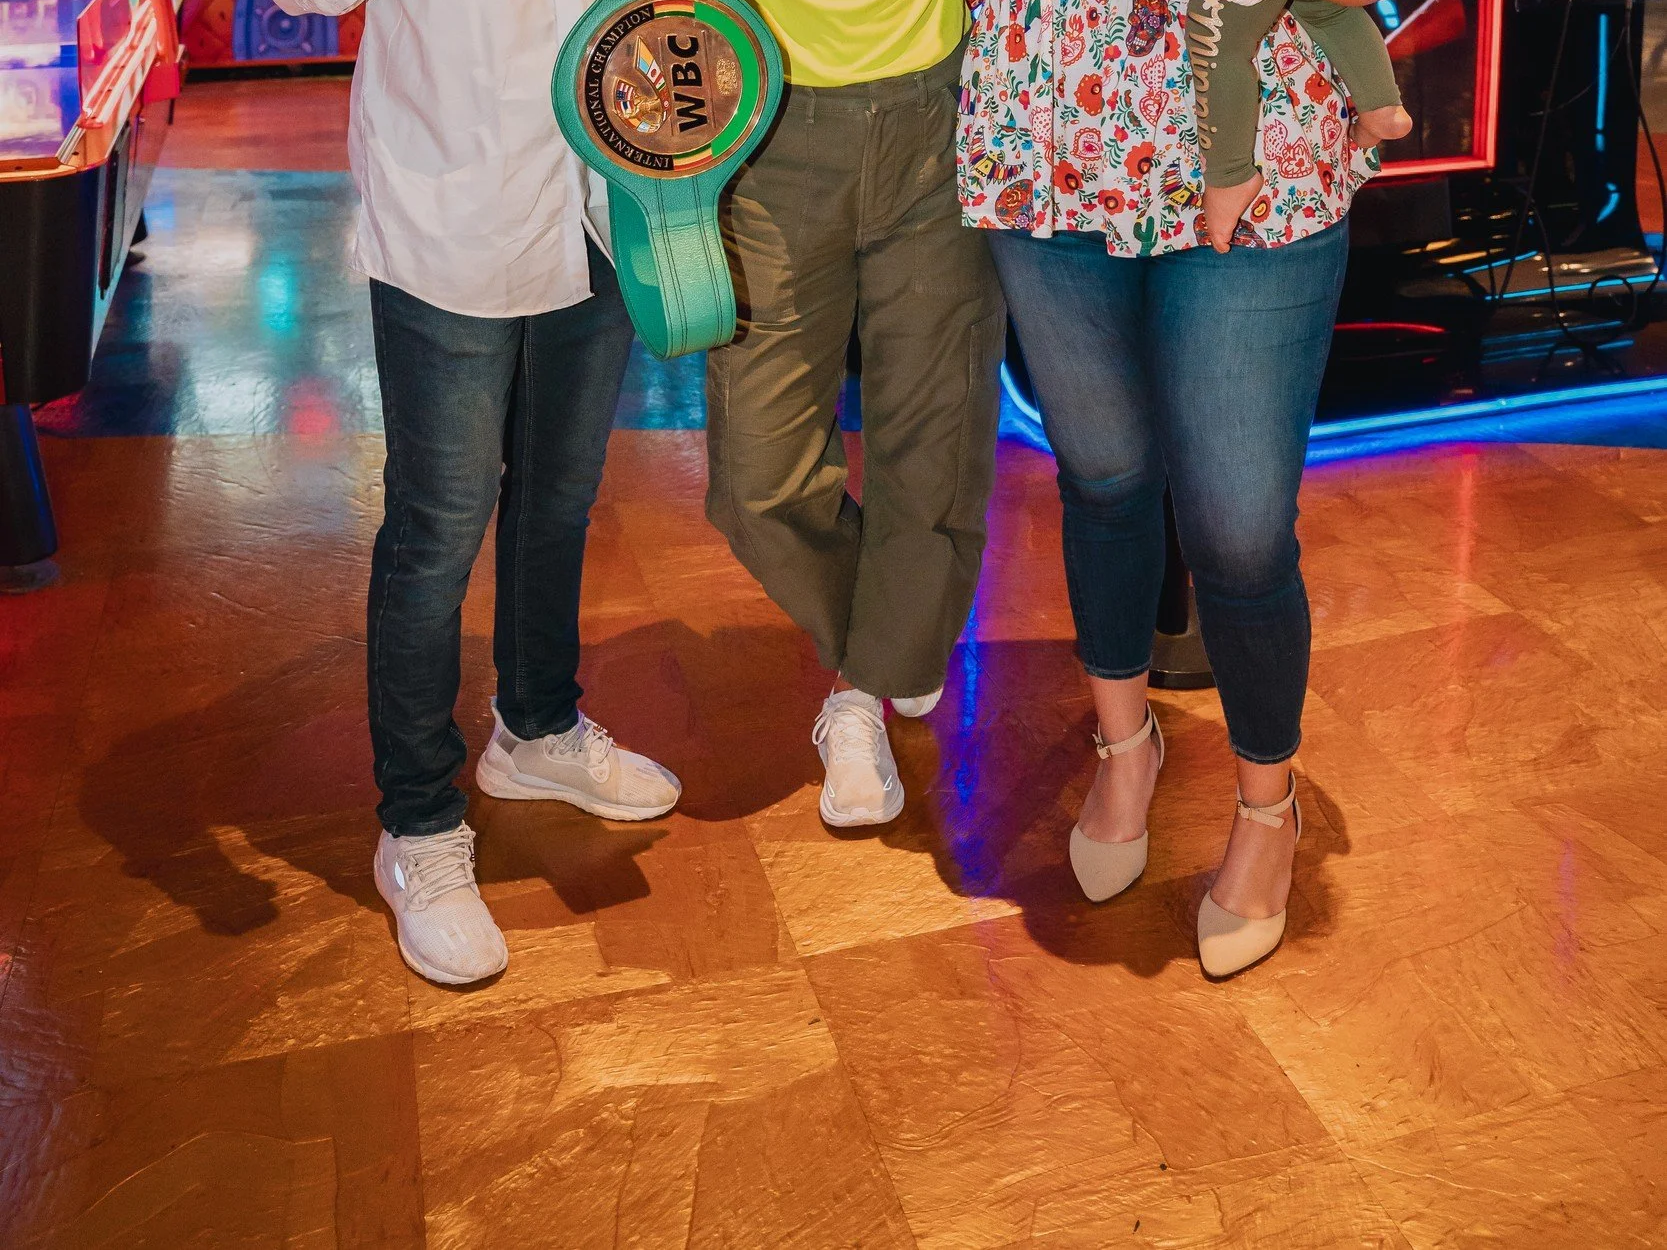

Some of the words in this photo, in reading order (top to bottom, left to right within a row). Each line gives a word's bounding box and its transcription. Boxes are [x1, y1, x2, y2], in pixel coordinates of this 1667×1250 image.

[592, 7, 651, 75] CHAMPION
[667, 34, 708, 133] WBC
[1188, 2, 1224, 150] Minnie
[588, 80, 670, 168] INTERNATIONAL
